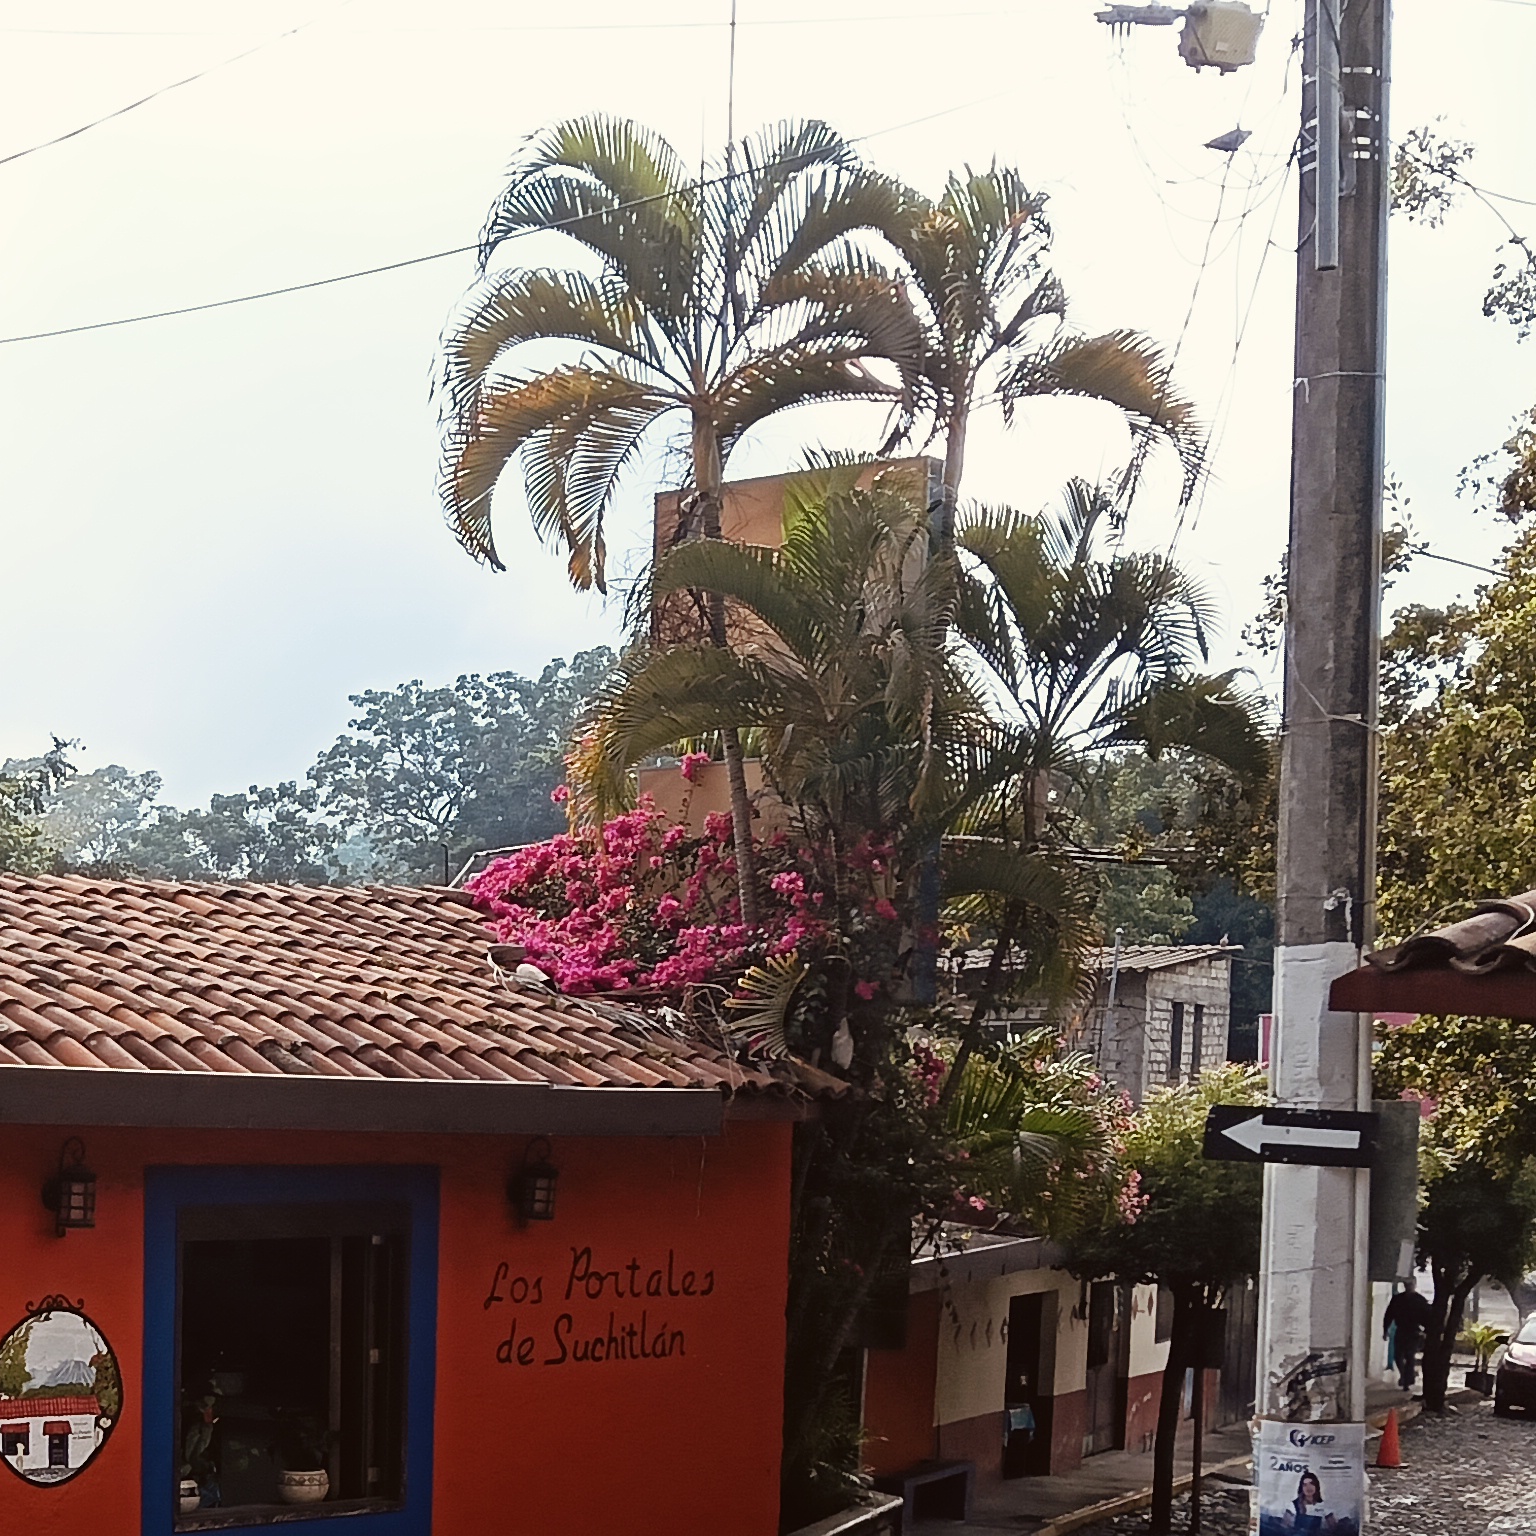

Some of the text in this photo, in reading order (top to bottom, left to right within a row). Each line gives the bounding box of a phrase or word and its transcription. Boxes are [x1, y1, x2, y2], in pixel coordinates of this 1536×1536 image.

[484, 1246, 714, 1310] Los Portales
[496, 1309, 686, 1366] de Suchitlán
